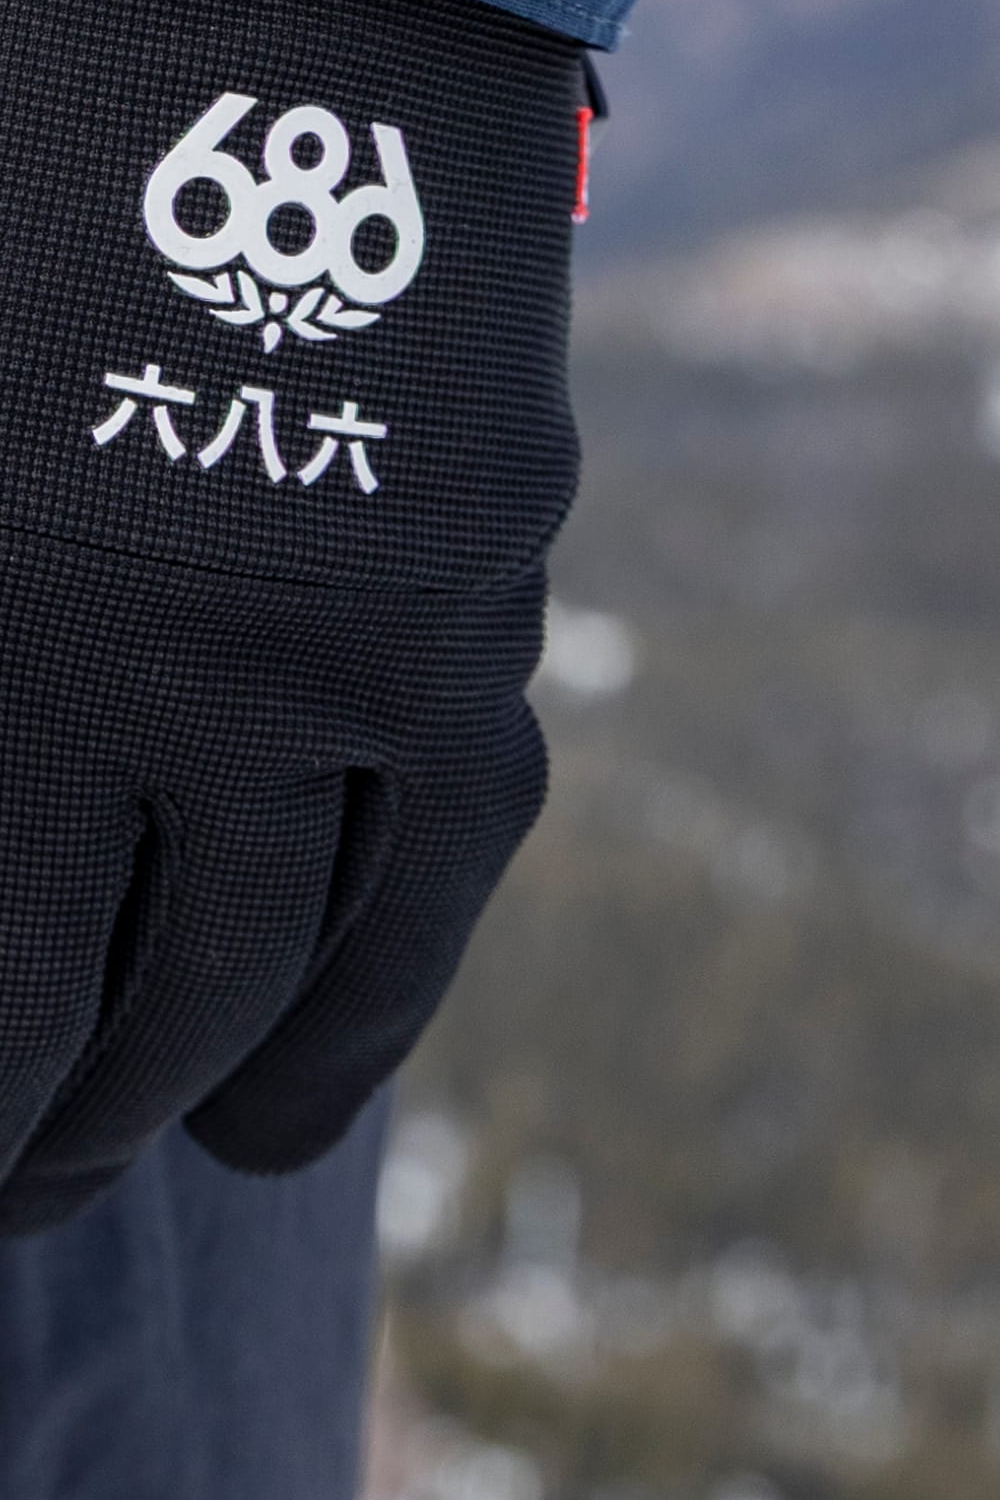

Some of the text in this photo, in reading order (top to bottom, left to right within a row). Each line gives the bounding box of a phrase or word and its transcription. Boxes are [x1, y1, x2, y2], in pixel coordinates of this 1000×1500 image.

[142, 91, 425, 306] 686
[91, 363, 387, 494] 六八六
